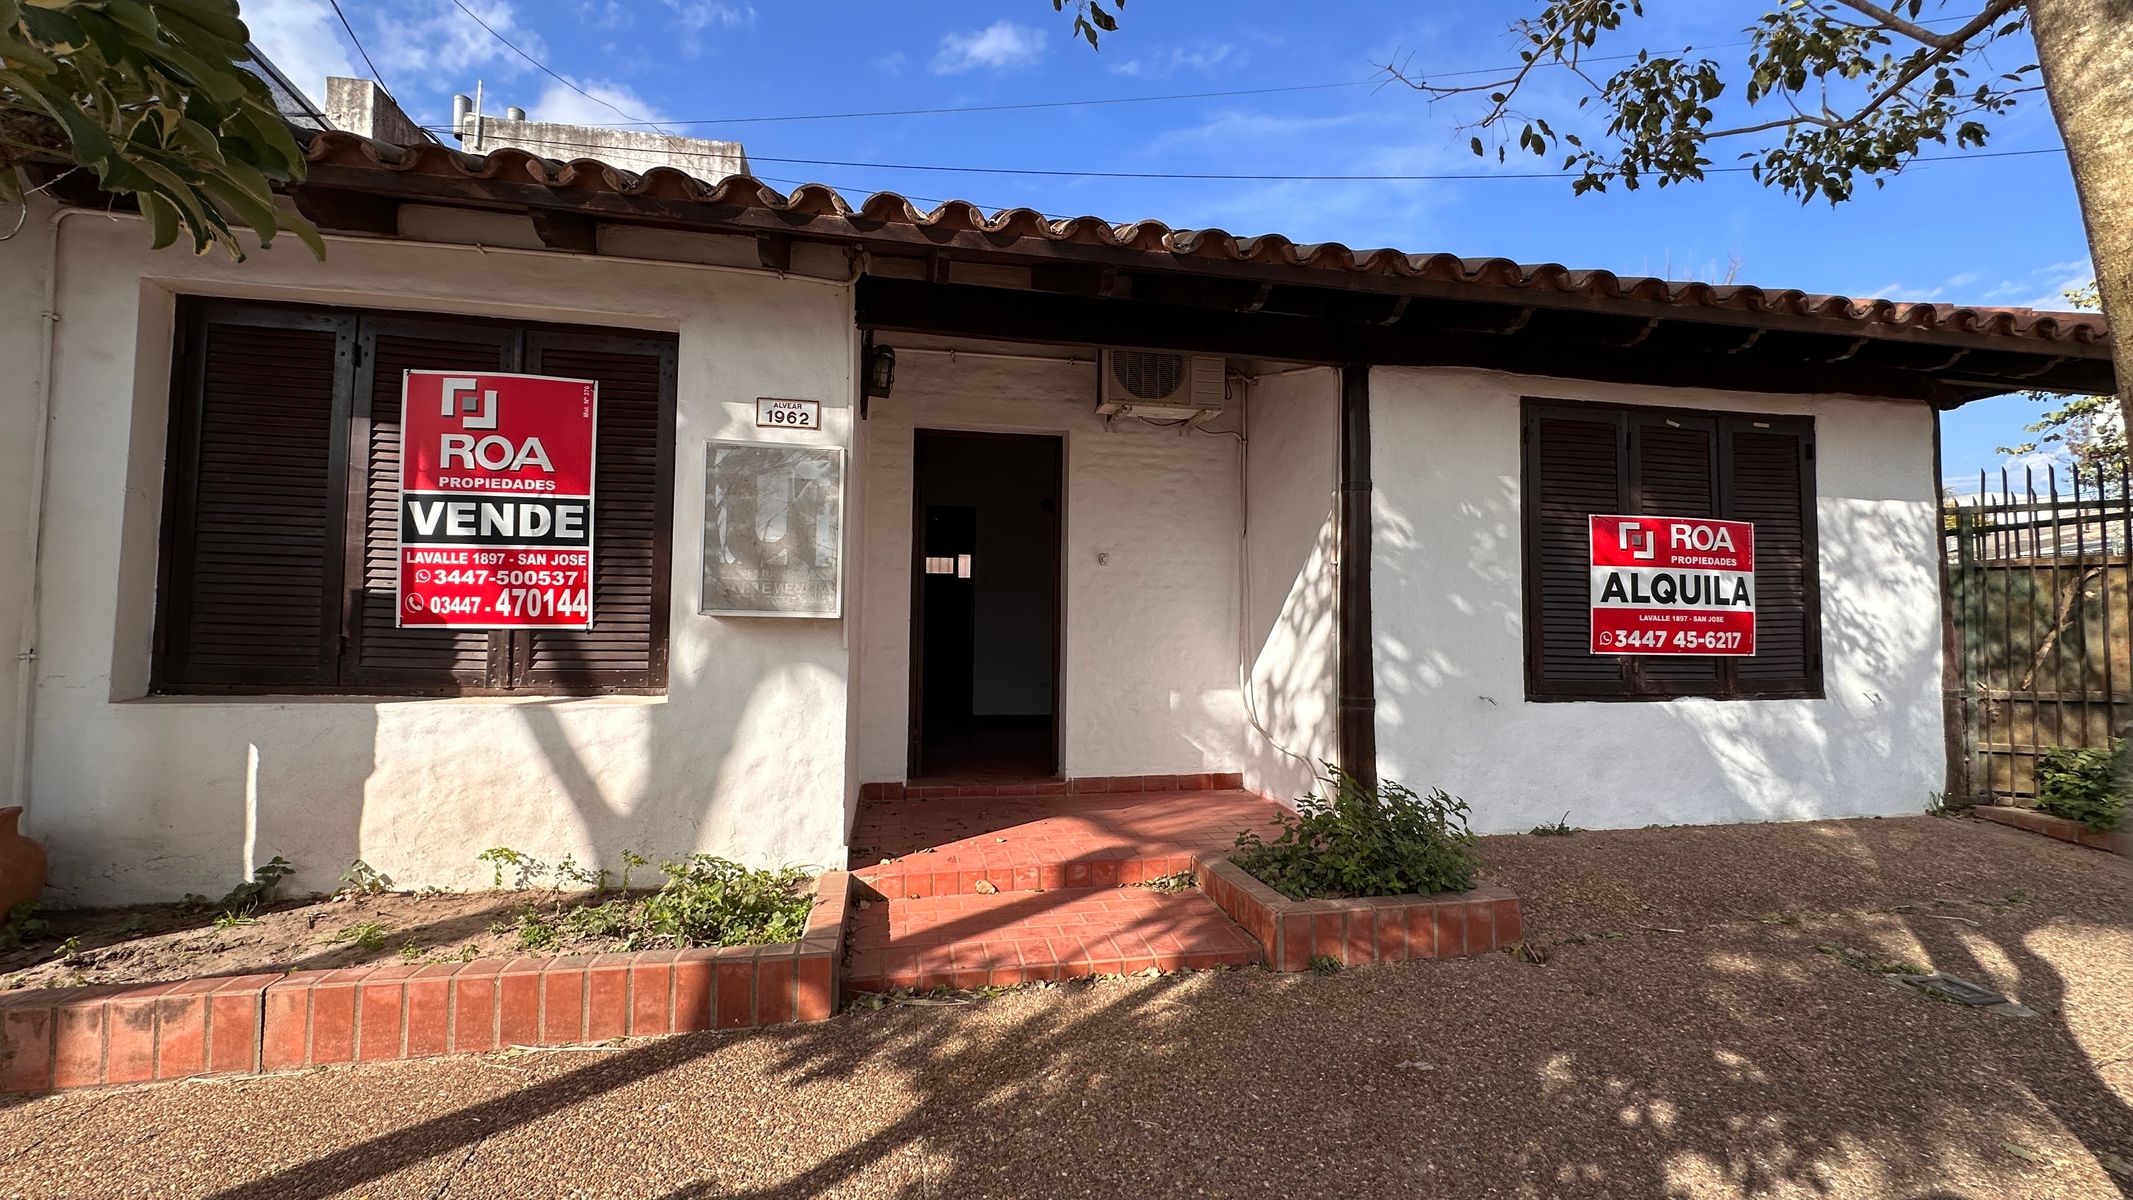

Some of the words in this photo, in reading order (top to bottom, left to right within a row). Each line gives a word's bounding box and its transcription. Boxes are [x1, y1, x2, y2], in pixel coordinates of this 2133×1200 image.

[773, 402, 803, 410] ALVEAR
[766, 410, 810, 425] 1962
[439, 433, 556, 473] ROA
[438, 476, 556, 491] PROPIEDADES
[407, 501, 584, 539] VENDE
[1670, 523, 1736, 553] ROA
[406, 552, 469, 565] LAVALLE
[472, 552, 506, 565] 1897
[517, 553, 547, 566] SAN
[550, 553, 587, 567] JOSE
[1671, 555, 1737, 567] PROPIEDADES
[433, 569, 579, 586] 3447-500537
[1600, 571, 1752, 607] ALQUILA
[430, 596, 481, 615] 03447
[495, 588, 588, 617] 470144
[1639, 614, 1671, 622] LAVALLE
[1614, 630, 1667, 648] 3447
[1672, 631, 1742, 649] 45-6217
